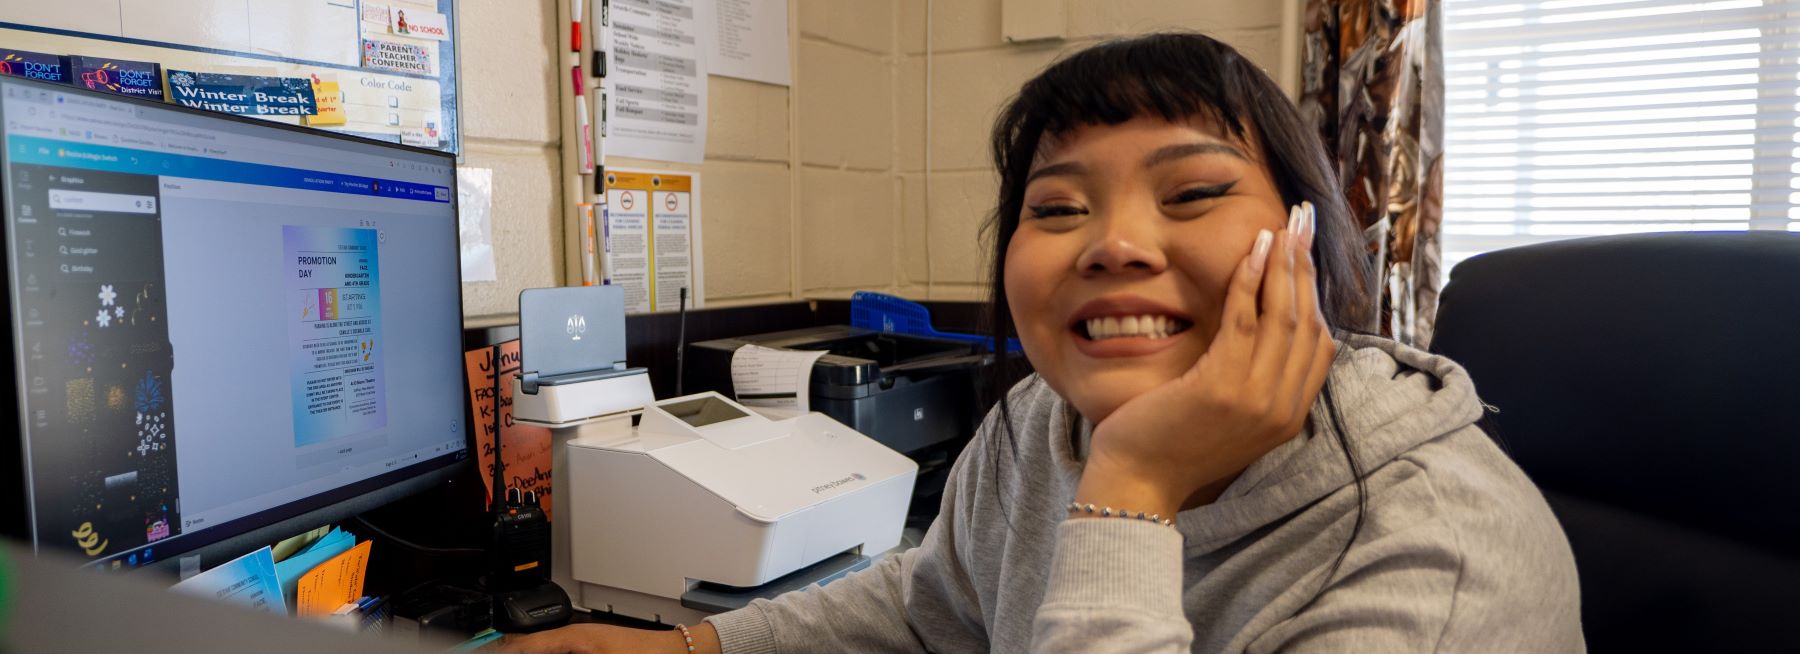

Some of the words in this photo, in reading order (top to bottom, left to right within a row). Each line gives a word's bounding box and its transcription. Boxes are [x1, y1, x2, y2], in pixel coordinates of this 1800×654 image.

[408, 24, 418, 32] NO
[419, 26, 444, 35] SCHOOL
[380, 44, 413, 54] PARENT
[380, 51, 416, 62] TEACHER
[24, 61, 60, 73] DON'T
[372, 58, 426, 70] CONFERENCE
[25, 71, 62, 81] FORGET
[119, 69, 151, 80] DON'T
[120, 77, 152, 87] FORGET
[360, 77, 385, 88] Color
[388, 80, 412, 92] Code:
[121, 87, 145, 95] District
[176, 86, 247, 102] Winter
[254, 91, 310, 104] Break
[180, 99, 248, 113] Winter
[256, 103, 311, 115] Break
[298, 256, 336, 265] PROMOTION
[298, 269, 312, 278] DAY
[325, 291, 333, 305] 16
